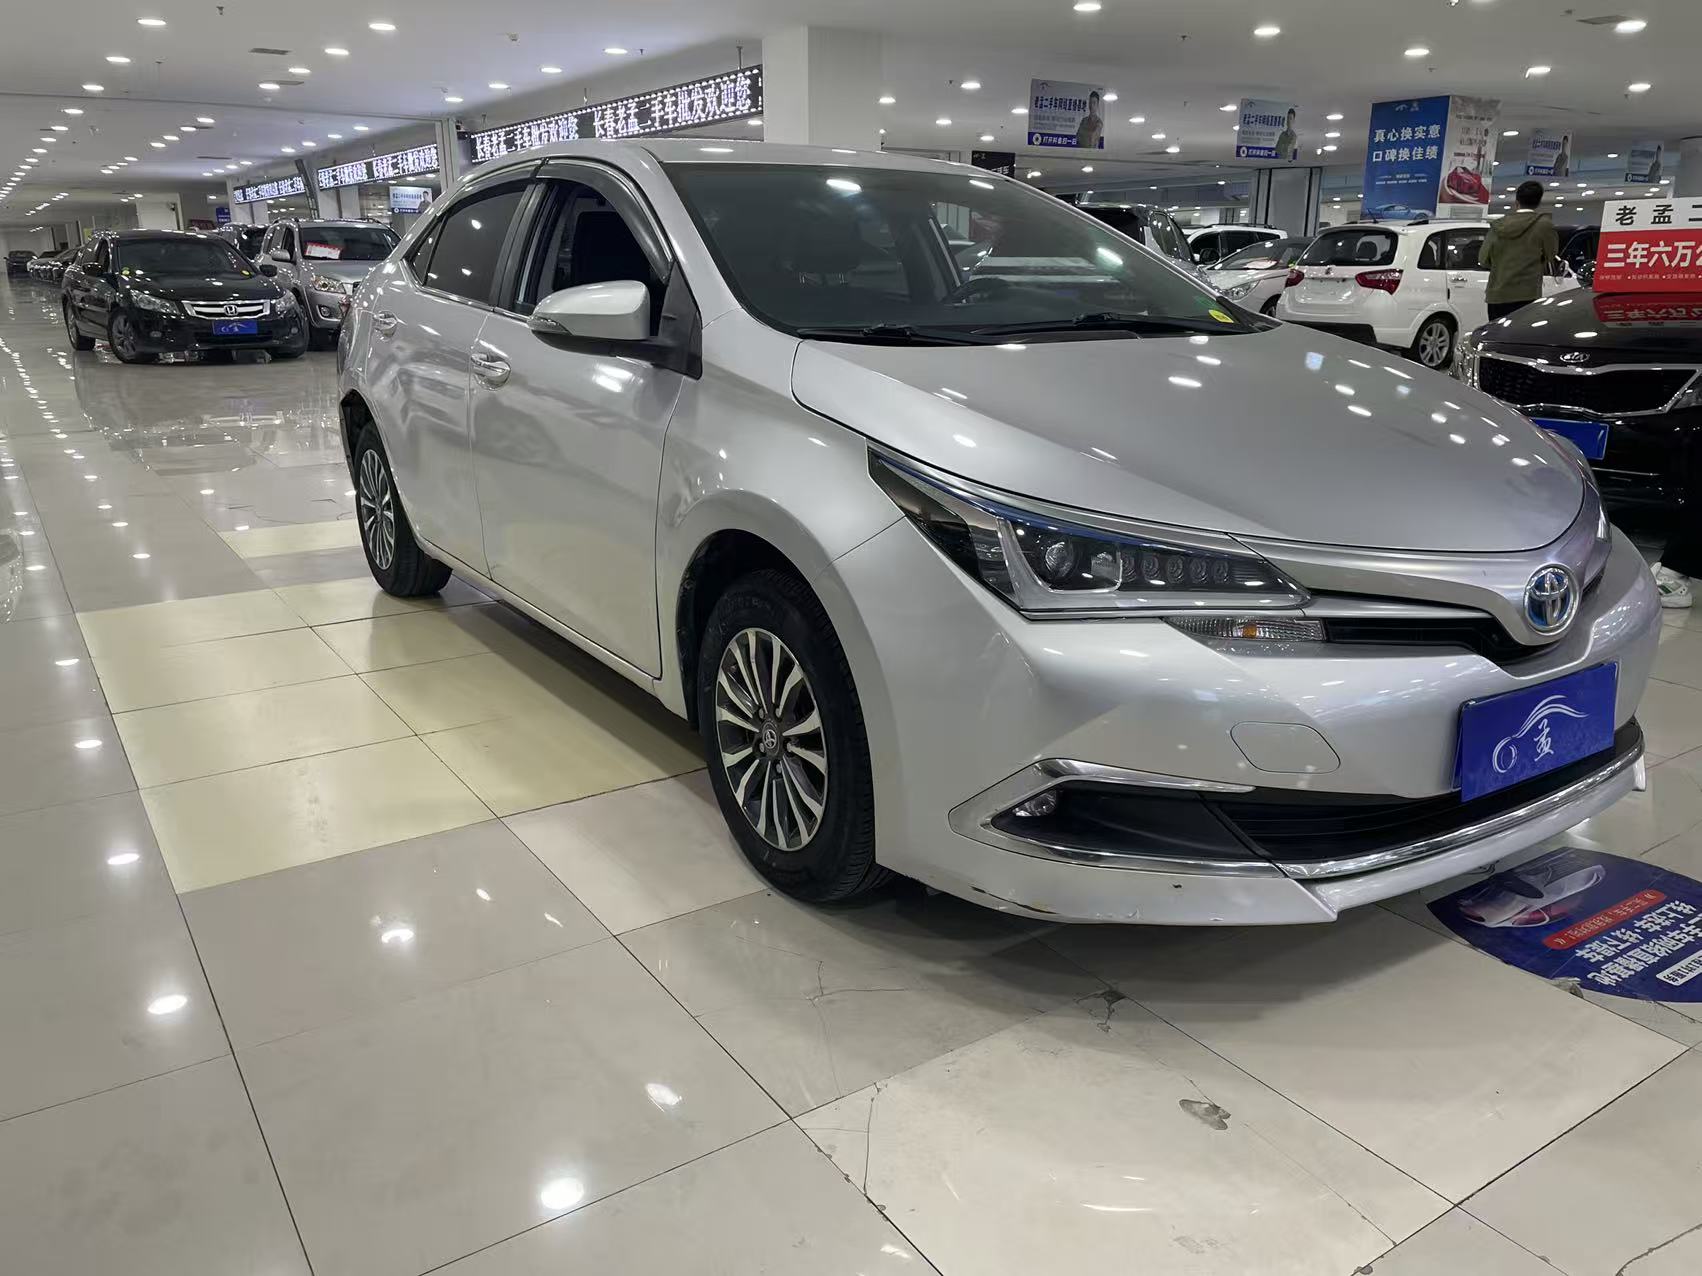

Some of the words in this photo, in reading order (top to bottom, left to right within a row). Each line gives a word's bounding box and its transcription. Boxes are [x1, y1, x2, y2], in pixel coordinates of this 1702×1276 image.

[592, 75, 751, 139] 长春老孟二手车批发欢迎您
[1373, 124, 1441, 142] 真心换实意
[1372, 146, 1439, 162] 口碑换佳绩
